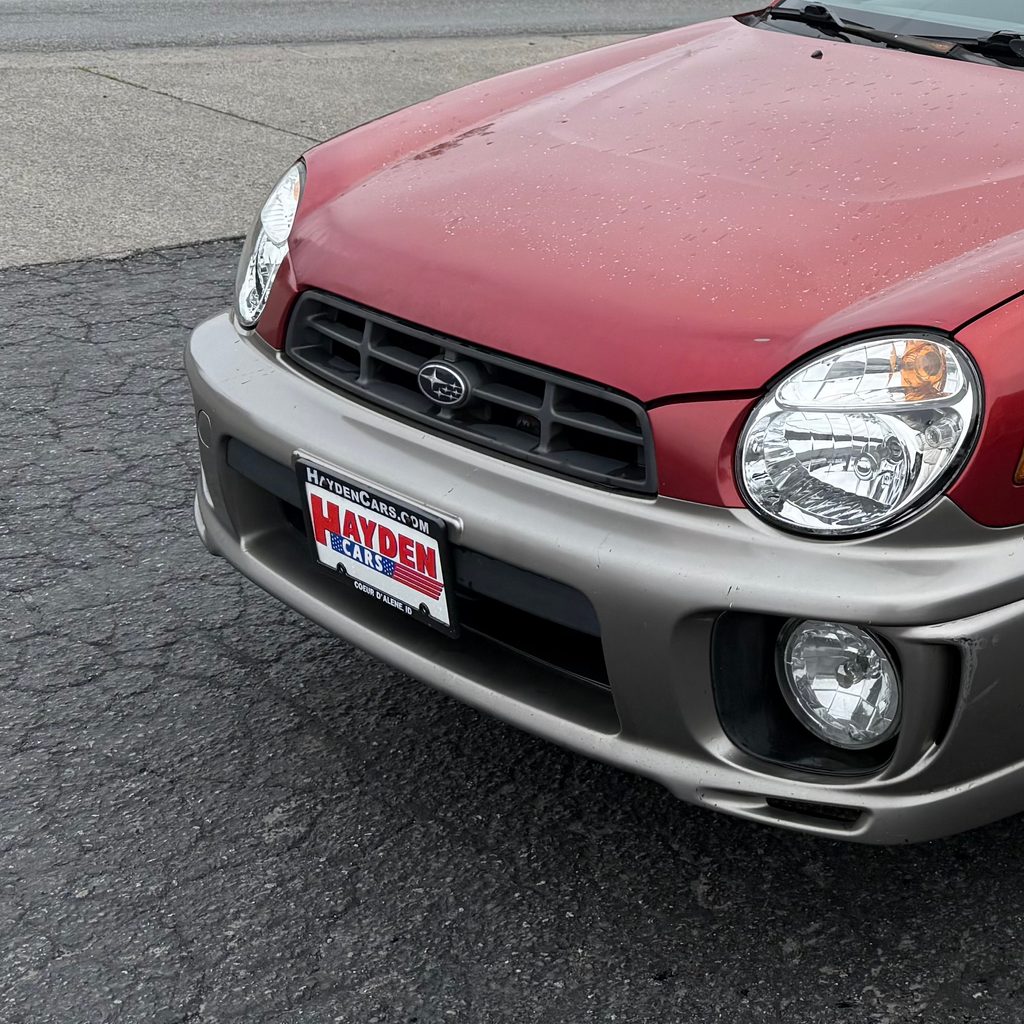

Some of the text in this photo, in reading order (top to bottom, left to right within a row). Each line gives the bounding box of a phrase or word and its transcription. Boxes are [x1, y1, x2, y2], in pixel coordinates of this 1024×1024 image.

[310, 493, 438, 579] HAYDEN
[342, 539, 384, 572] CARS
[354, 580, 375, 596] COEUR
[404, 605, 413, 615] ID
